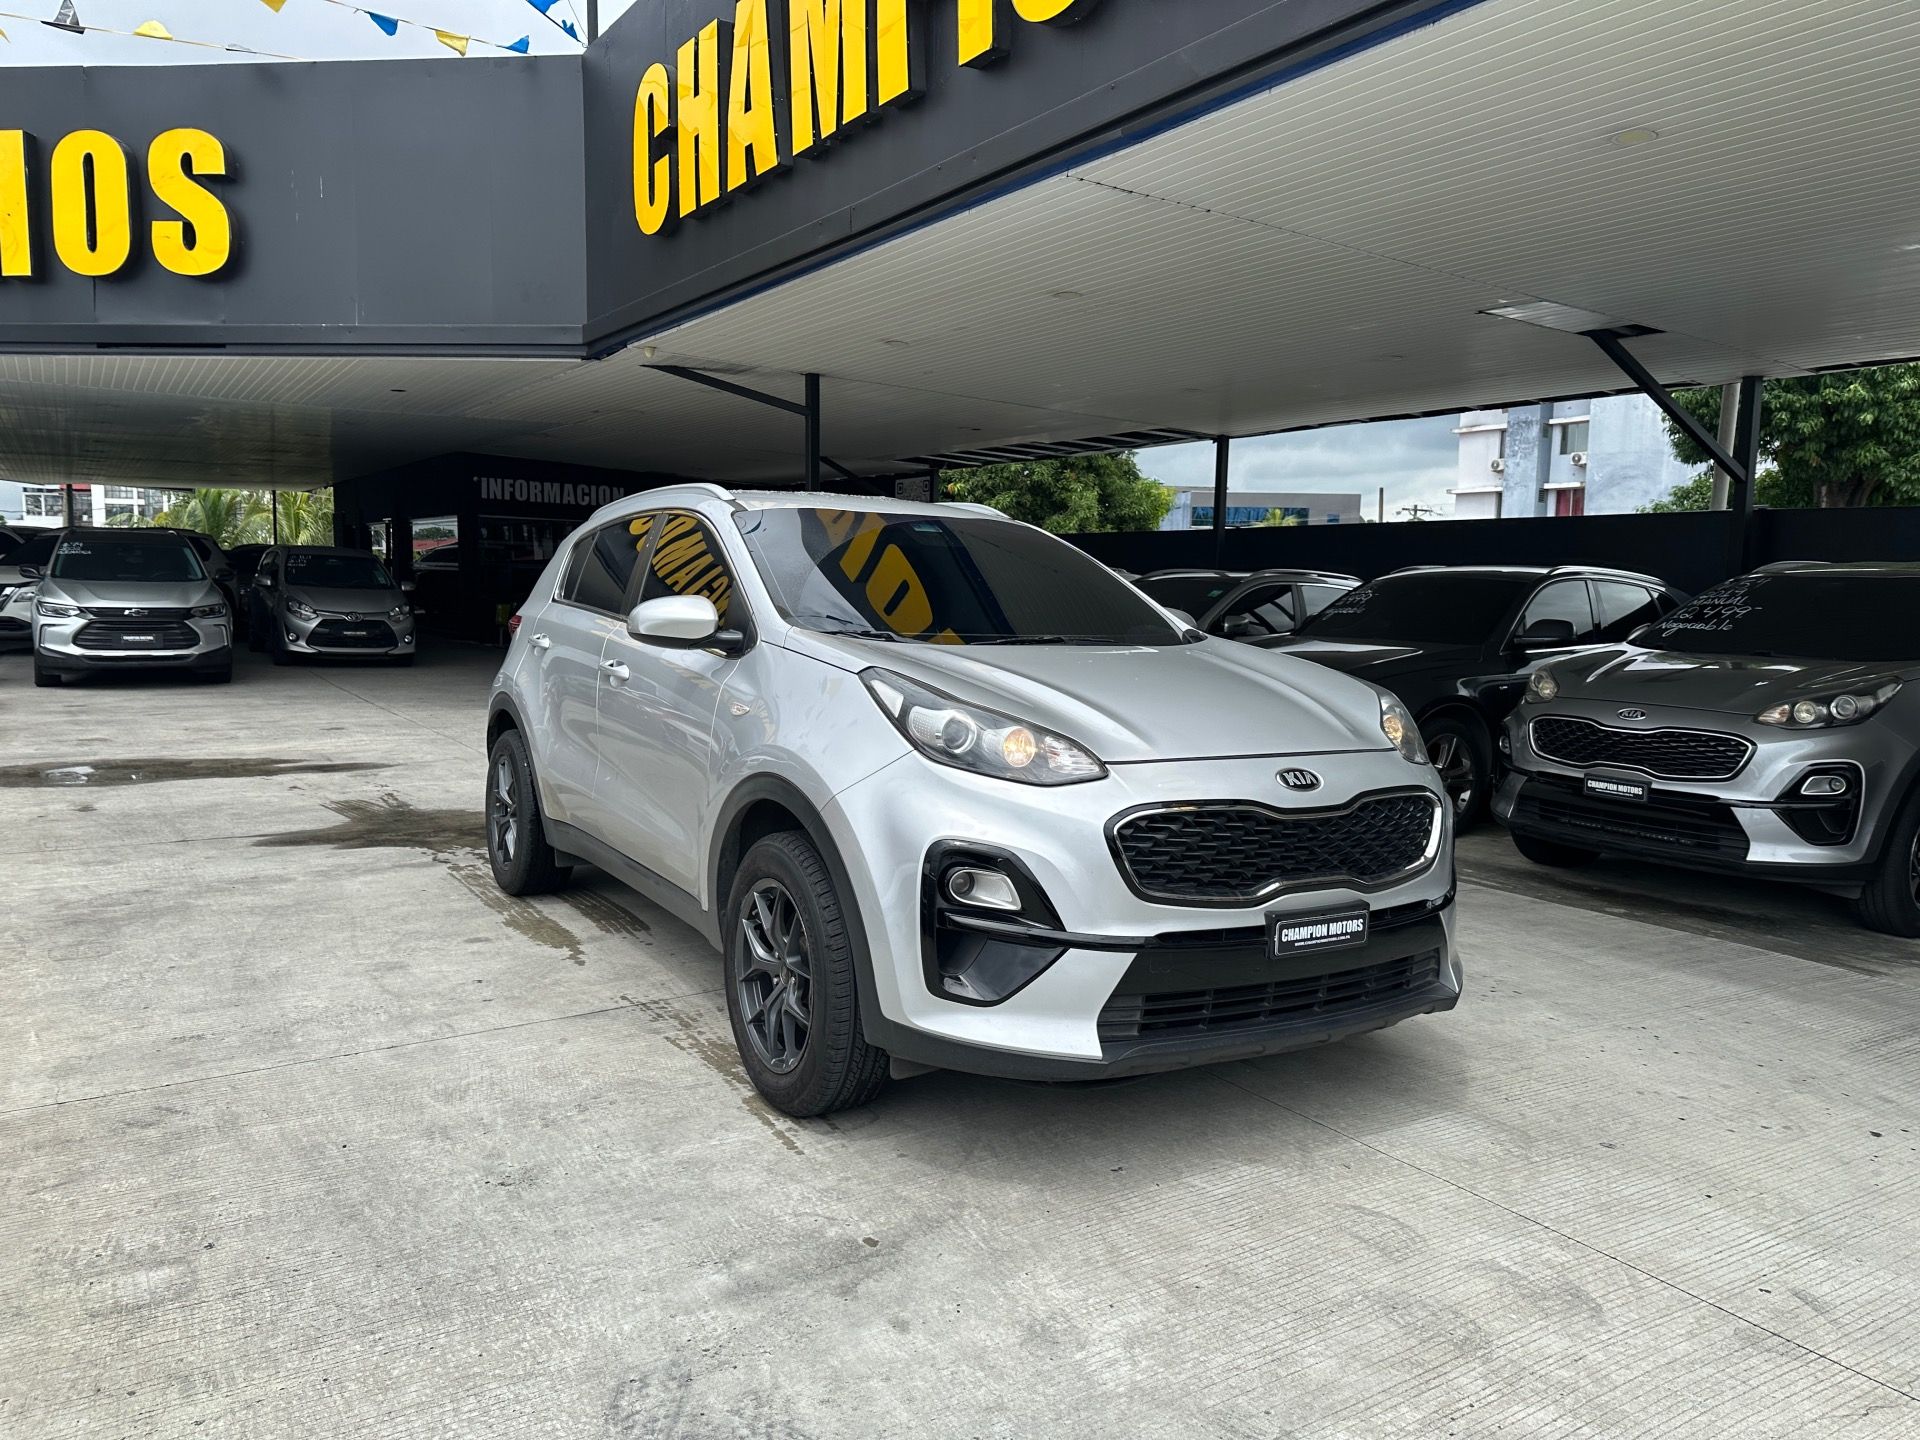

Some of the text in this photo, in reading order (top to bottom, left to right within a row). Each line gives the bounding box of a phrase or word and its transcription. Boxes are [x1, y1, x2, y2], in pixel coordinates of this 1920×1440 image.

[633, 0, 1079, 235] CHAM
[1282, 771, 1318, 786] KIA
[1587, 779, 1617, 792] CHAMPION
[1618, 784, 1643, 795] MOTORS
[1281, 918, 1364, 942] CHAMPION MOTORS
